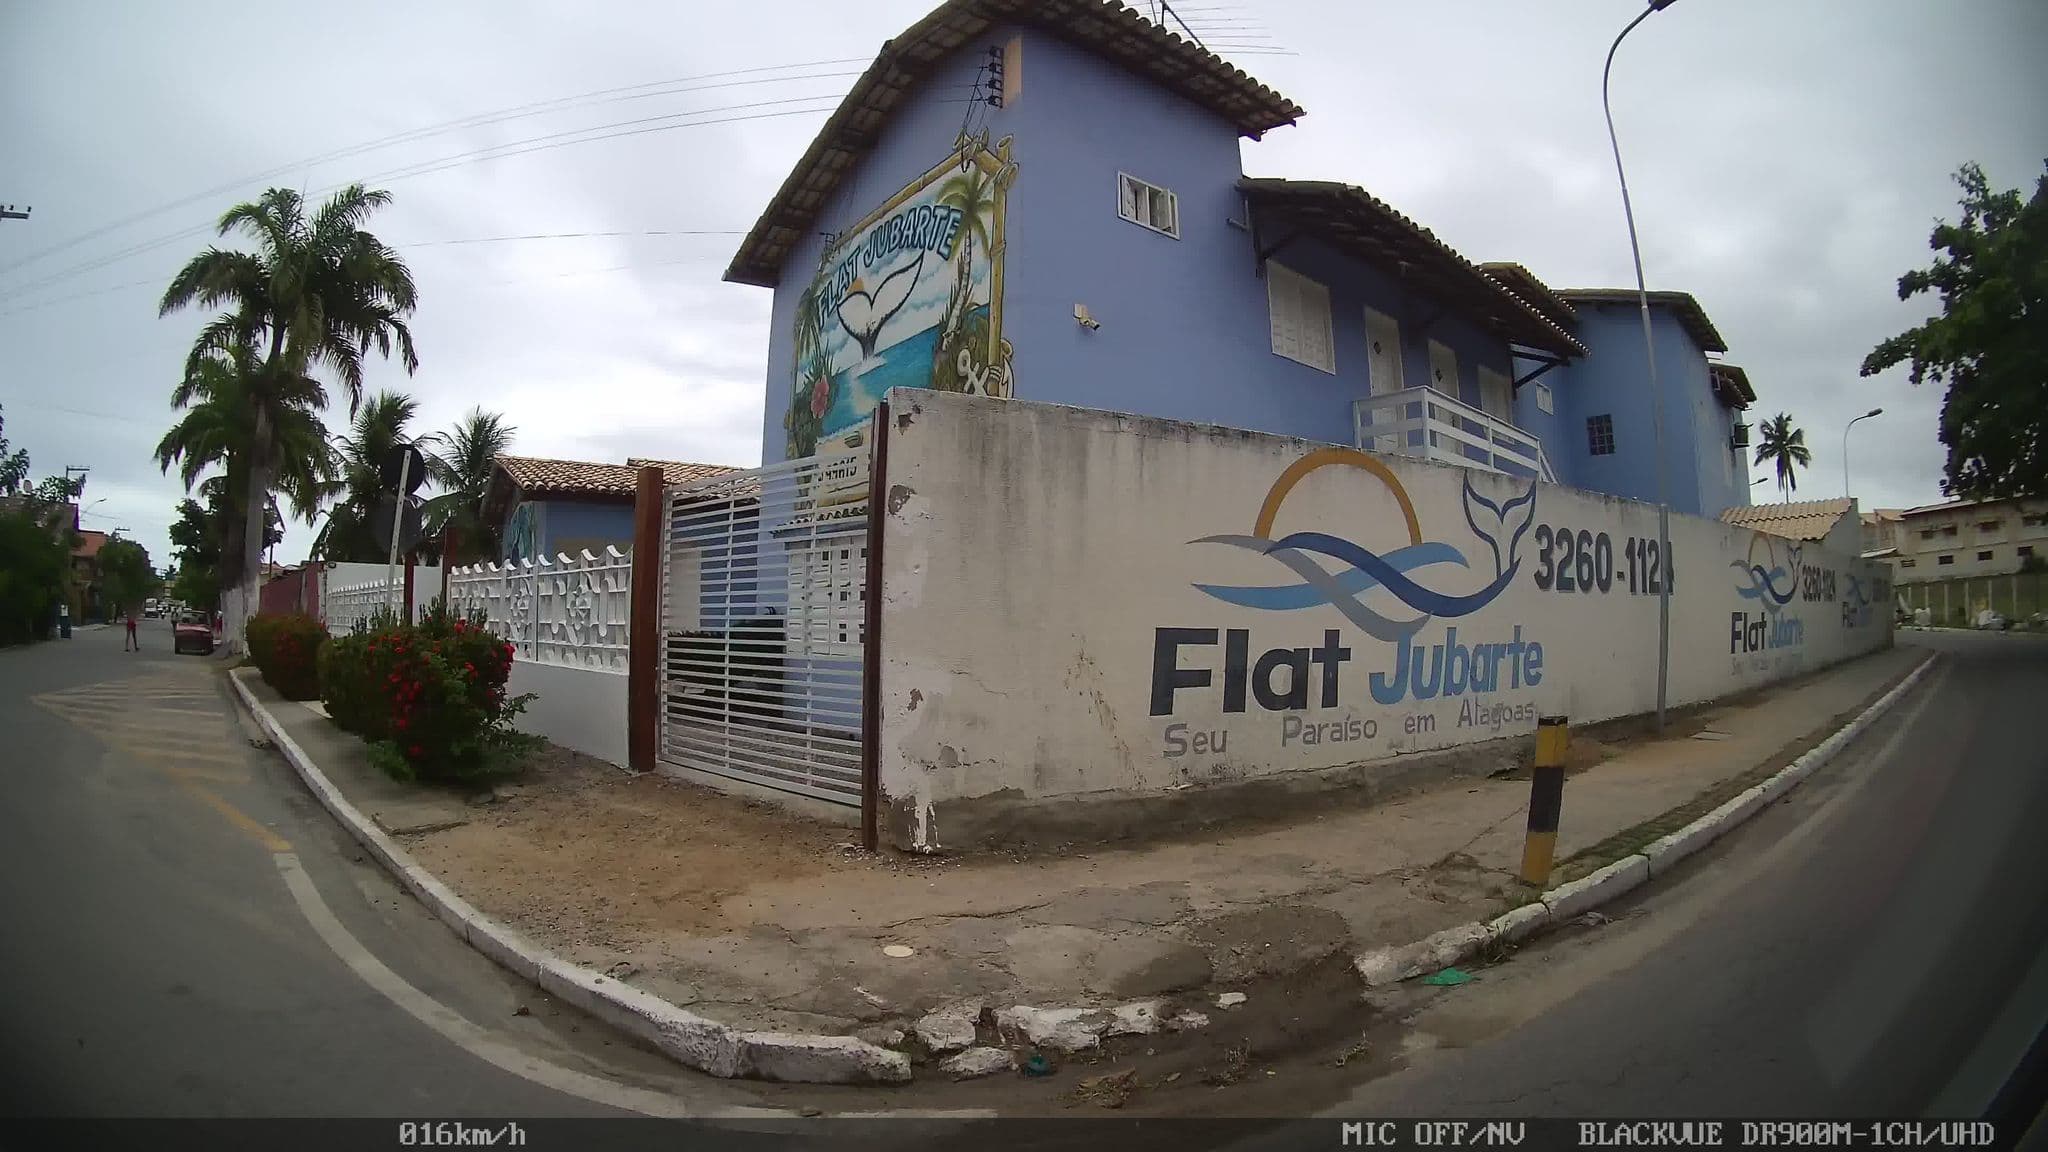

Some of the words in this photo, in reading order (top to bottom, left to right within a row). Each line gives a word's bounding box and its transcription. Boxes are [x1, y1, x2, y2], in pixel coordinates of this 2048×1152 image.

[817, 247, 860, 329] FLAT
[863, 205, 963, 261] JUBARTE
[1149, 627, 1352, 717] Flat
[1368, 625, 1544, 705] Jubarte
[1730, 611, 1767, 654] Flat
[1163, 723, 1228, 758] Seu
[1281, 713, 1378, 748] Paraíso
[1404, 713, 1436, 735] em
[1456, 696, 1535, 732] Alagoas
